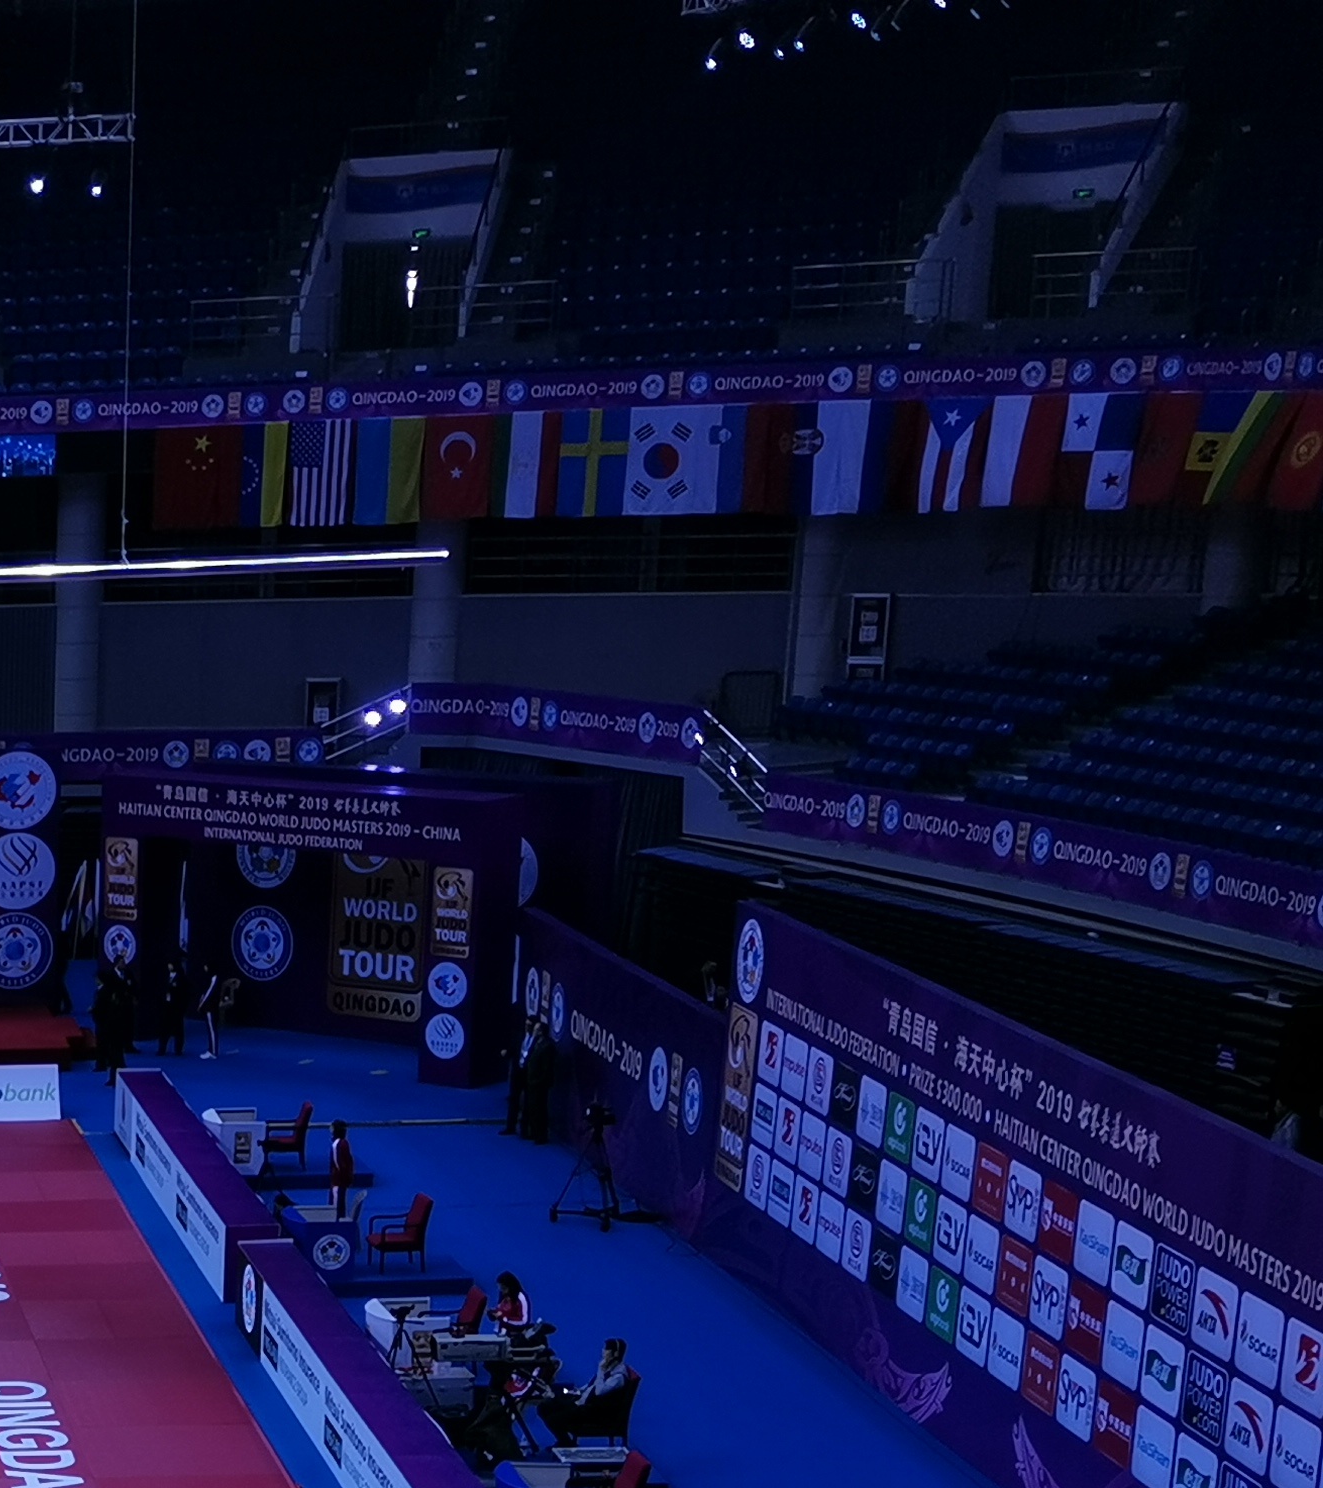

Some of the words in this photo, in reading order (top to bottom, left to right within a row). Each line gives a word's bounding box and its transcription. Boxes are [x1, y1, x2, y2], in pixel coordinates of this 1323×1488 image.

[530, 381, 638, 398] QINGDAO-2019
[713, 373, 826, 391] QINGDAO-2019
[903, 366, 1018, 385] QINGDAO-2019
[97, 401, 199, 417] QINGDAO-2019
[351, 389, 456, 406] QINGDAO-2019
[299, 796, 329, 811] 2019
[118, 802, 163, 818] HAITIAN
[164, 805, 202, 821] CENTER
[204, 809, 257, 826] QINGDAO
[259, 814, 299, 830] WORLD
[300, 818, 332, 832] JUDO
[333, 820, 383, 836] MASTERS
[385, 823, 411, 838] 2019
[422, 825, 461, 842] CHINA
[902, 810, 991, 845] QINGDAO-2019
[205, 826, 276, 845] INTERNATIONAL
[277, 833, 303, 846] JUDO
[304, 834, 363, 850] FEDERATION
[1053, 839, 1148, 877] QINGDAO-2019
[365, 877, 394, 899] IJF
[1214, 874, 1317, 916] QINGDAO-2019
[343, 898, 418, 923] WORLD
[338, 919, 416, 953] JUDO
[338, 949, 415, 984] TOUR
[333, 992, 415, 1018] QINGDAO
[570, 1008, 643, 1081] QINGDAO-2019
[1036, 1080, 1074, 1124] 2019
[766, 987, 825, 1040] INTERNATIONAL
[826, 1019, 848, 1049] JUDO
[848, 1026, 900, 1078] FEDERATION
[909, 1062, 936, 1099] PRIZE
[993, 1112, 1039, 1156] HAITIAN
[1039, 1135, 1081, 1180] CENTER
[1081, 1156, 1141, 1212] QINGDAO
[1142, 1187, 1189, 1236] WORLD
[1188, 1216, 1226, 1259] JUDO
[1226, 1234, 1291, 1294] MASTERS
[1291, 1267, 1323, 1312] 2019
[1158, 1250, 1191, 1289] JUDO
[1156, 1275, 1189, 1310] POWER
[1196, 1309, 1217, 1336] ANTA
[1248, 1338, 1278, 1364] SOCAR
[1189, 1358, 1224, 1399] JUDO
[1187, 1383, 1222, 1421] POWER
[1230, 1421, 1251, 1448] ANTA
[1283, 1450, 1315, 1481] SOCAR
